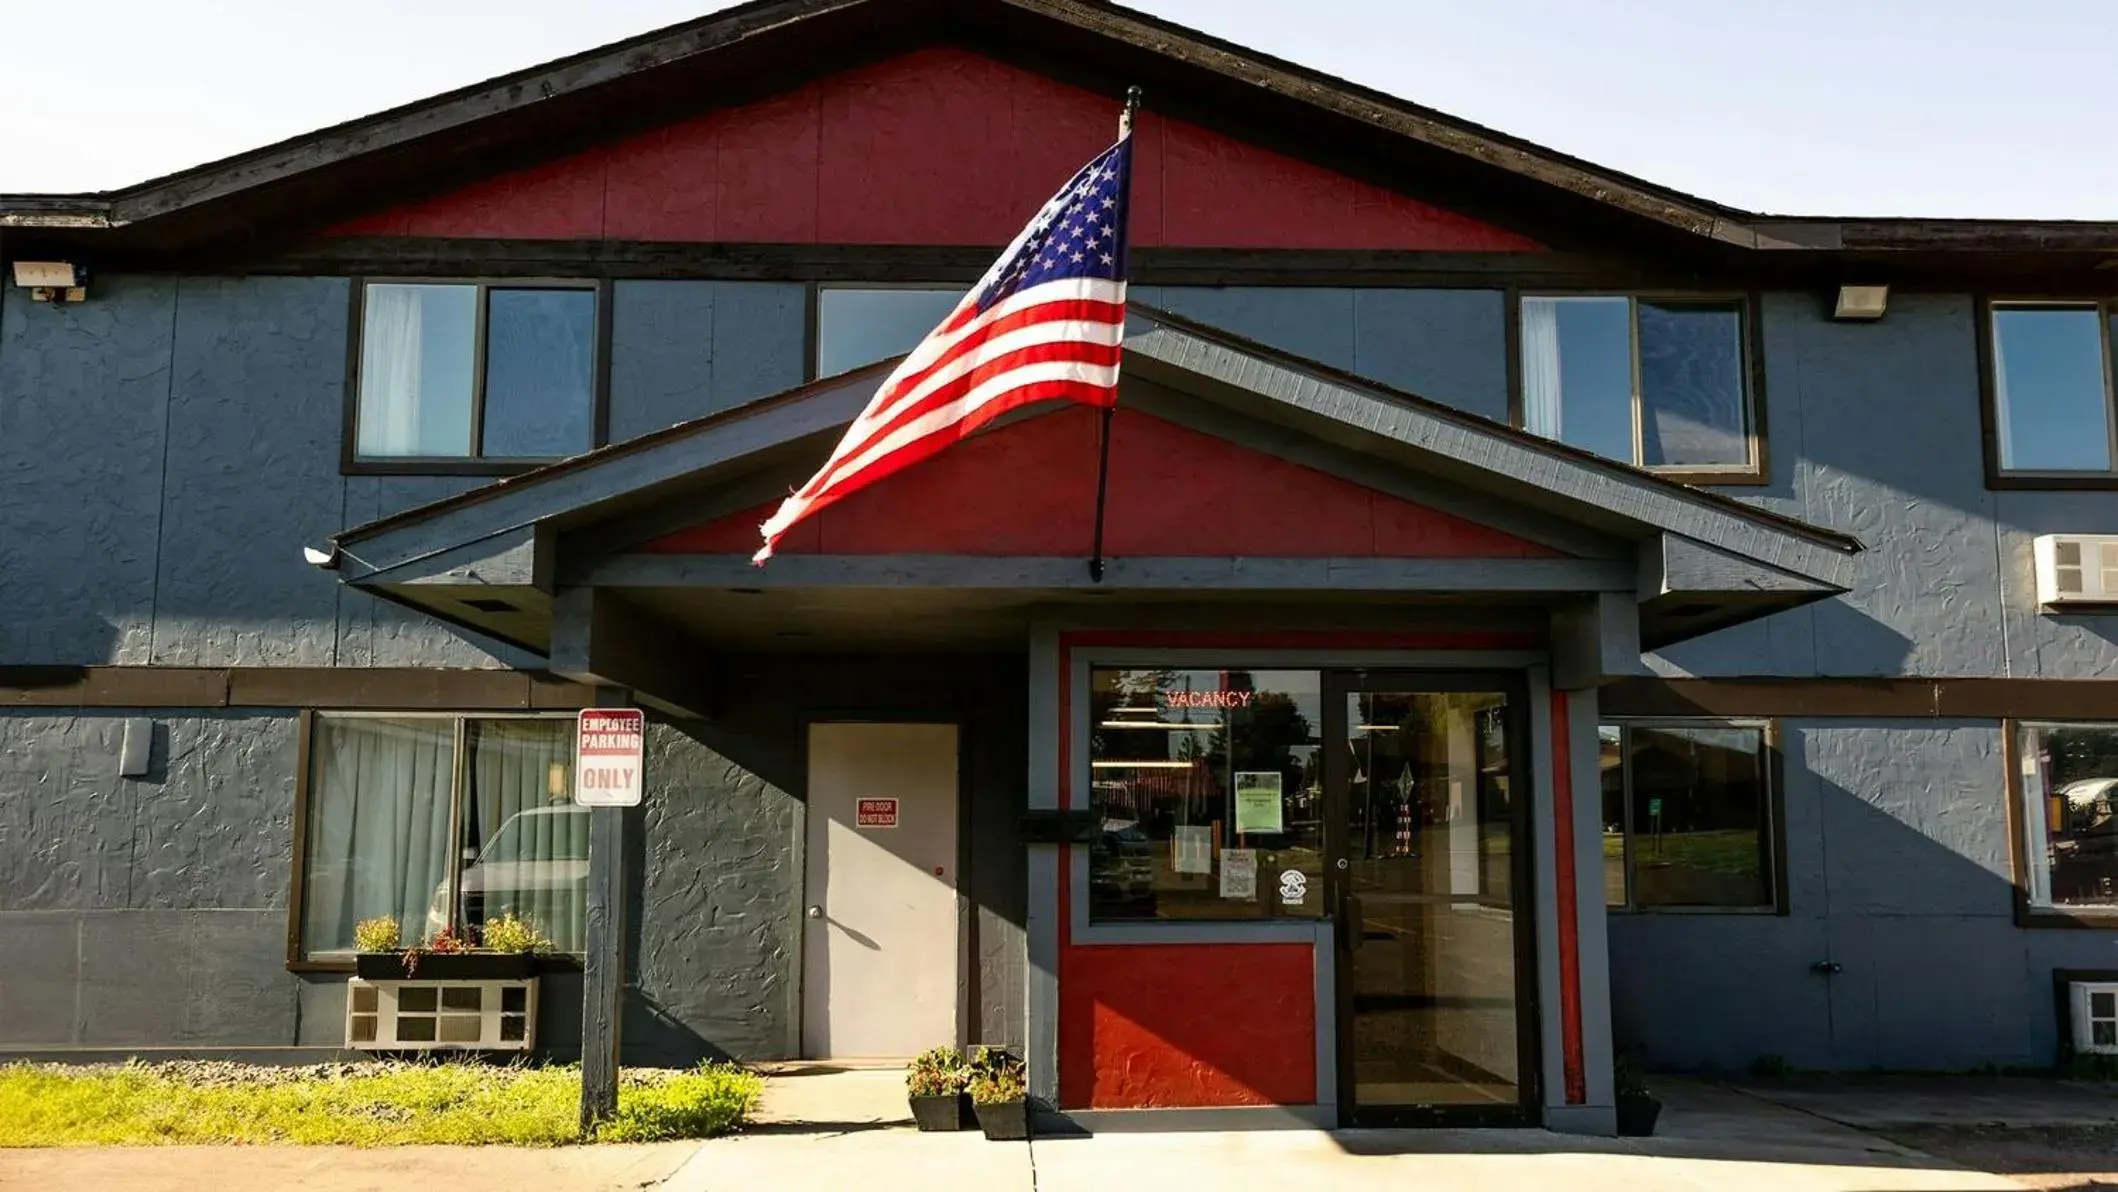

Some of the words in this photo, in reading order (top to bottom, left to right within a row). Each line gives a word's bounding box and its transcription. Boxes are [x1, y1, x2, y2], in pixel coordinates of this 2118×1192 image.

[1166, 691, 1250, 707] VACANCY
[582, 718, 639, 731] EMPLOYEE
[582, 733, 639, 748] PARKING
[584, 768, 634, 789] ONLY
